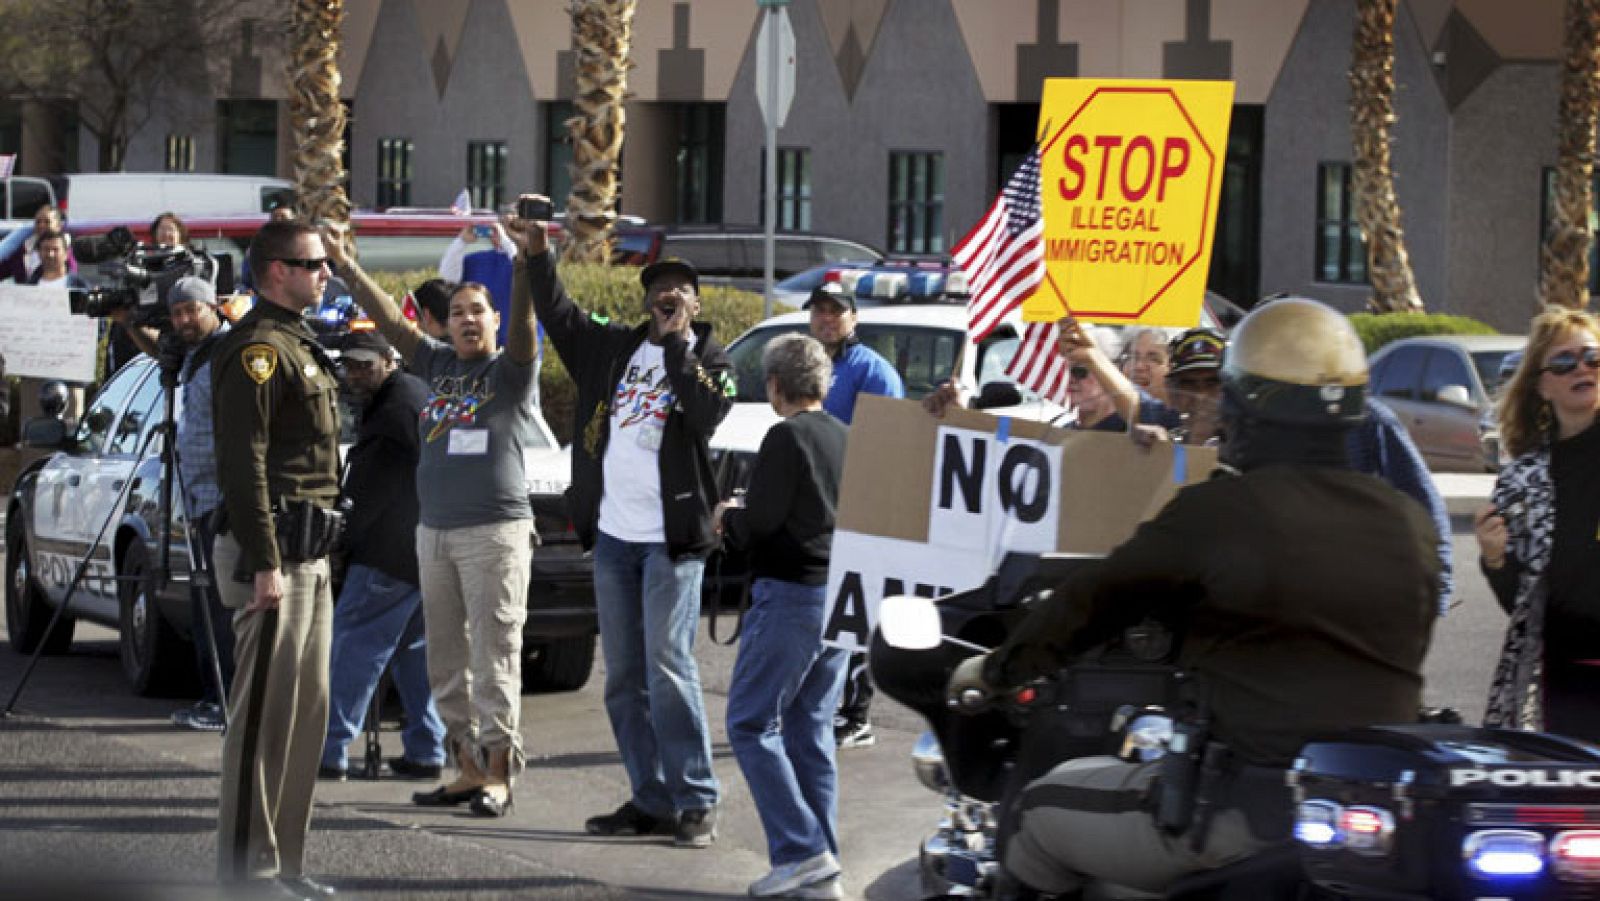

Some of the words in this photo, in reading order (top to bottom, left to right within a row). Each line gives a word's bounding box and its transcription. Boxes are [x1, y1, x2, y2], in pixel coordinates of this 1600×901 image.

[1058, 134, 1191, 203] STOP
[1070, 205, 1161, 232] ILLEGAL
[1046, 239, 1186, 266] IMMIGRATION
[939, 433, 1051, 524] NO
[36, 552, 120, 599] POCE
